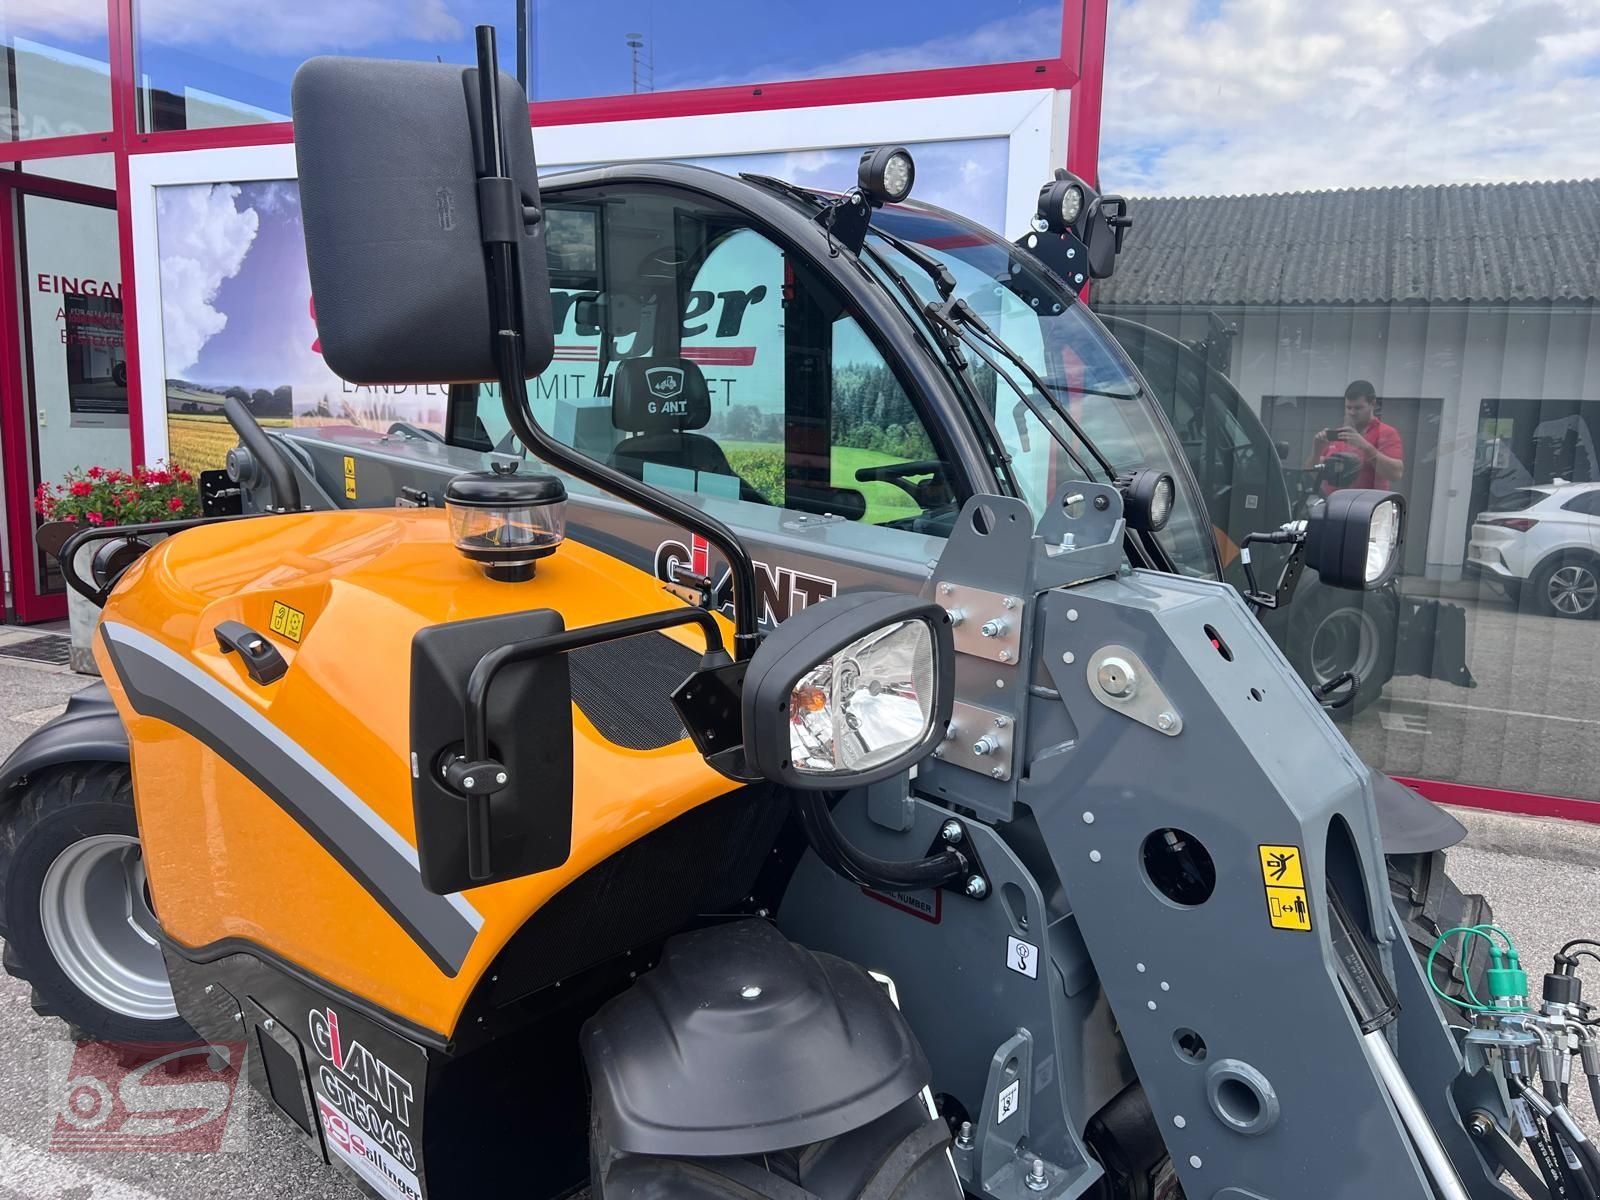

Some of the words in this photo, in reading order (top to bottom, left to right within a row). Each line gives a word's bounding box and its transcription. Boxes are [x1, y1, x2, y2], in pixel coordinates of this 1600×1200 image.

[536, 374, 586, 400] MIT
[648, 400, 687, 413] GANT
[898, 892, 932, 912] NUMBER
[319, 1065, 417, 1172] GT5048
[351, 1134, 421, 1200] Söllinger
